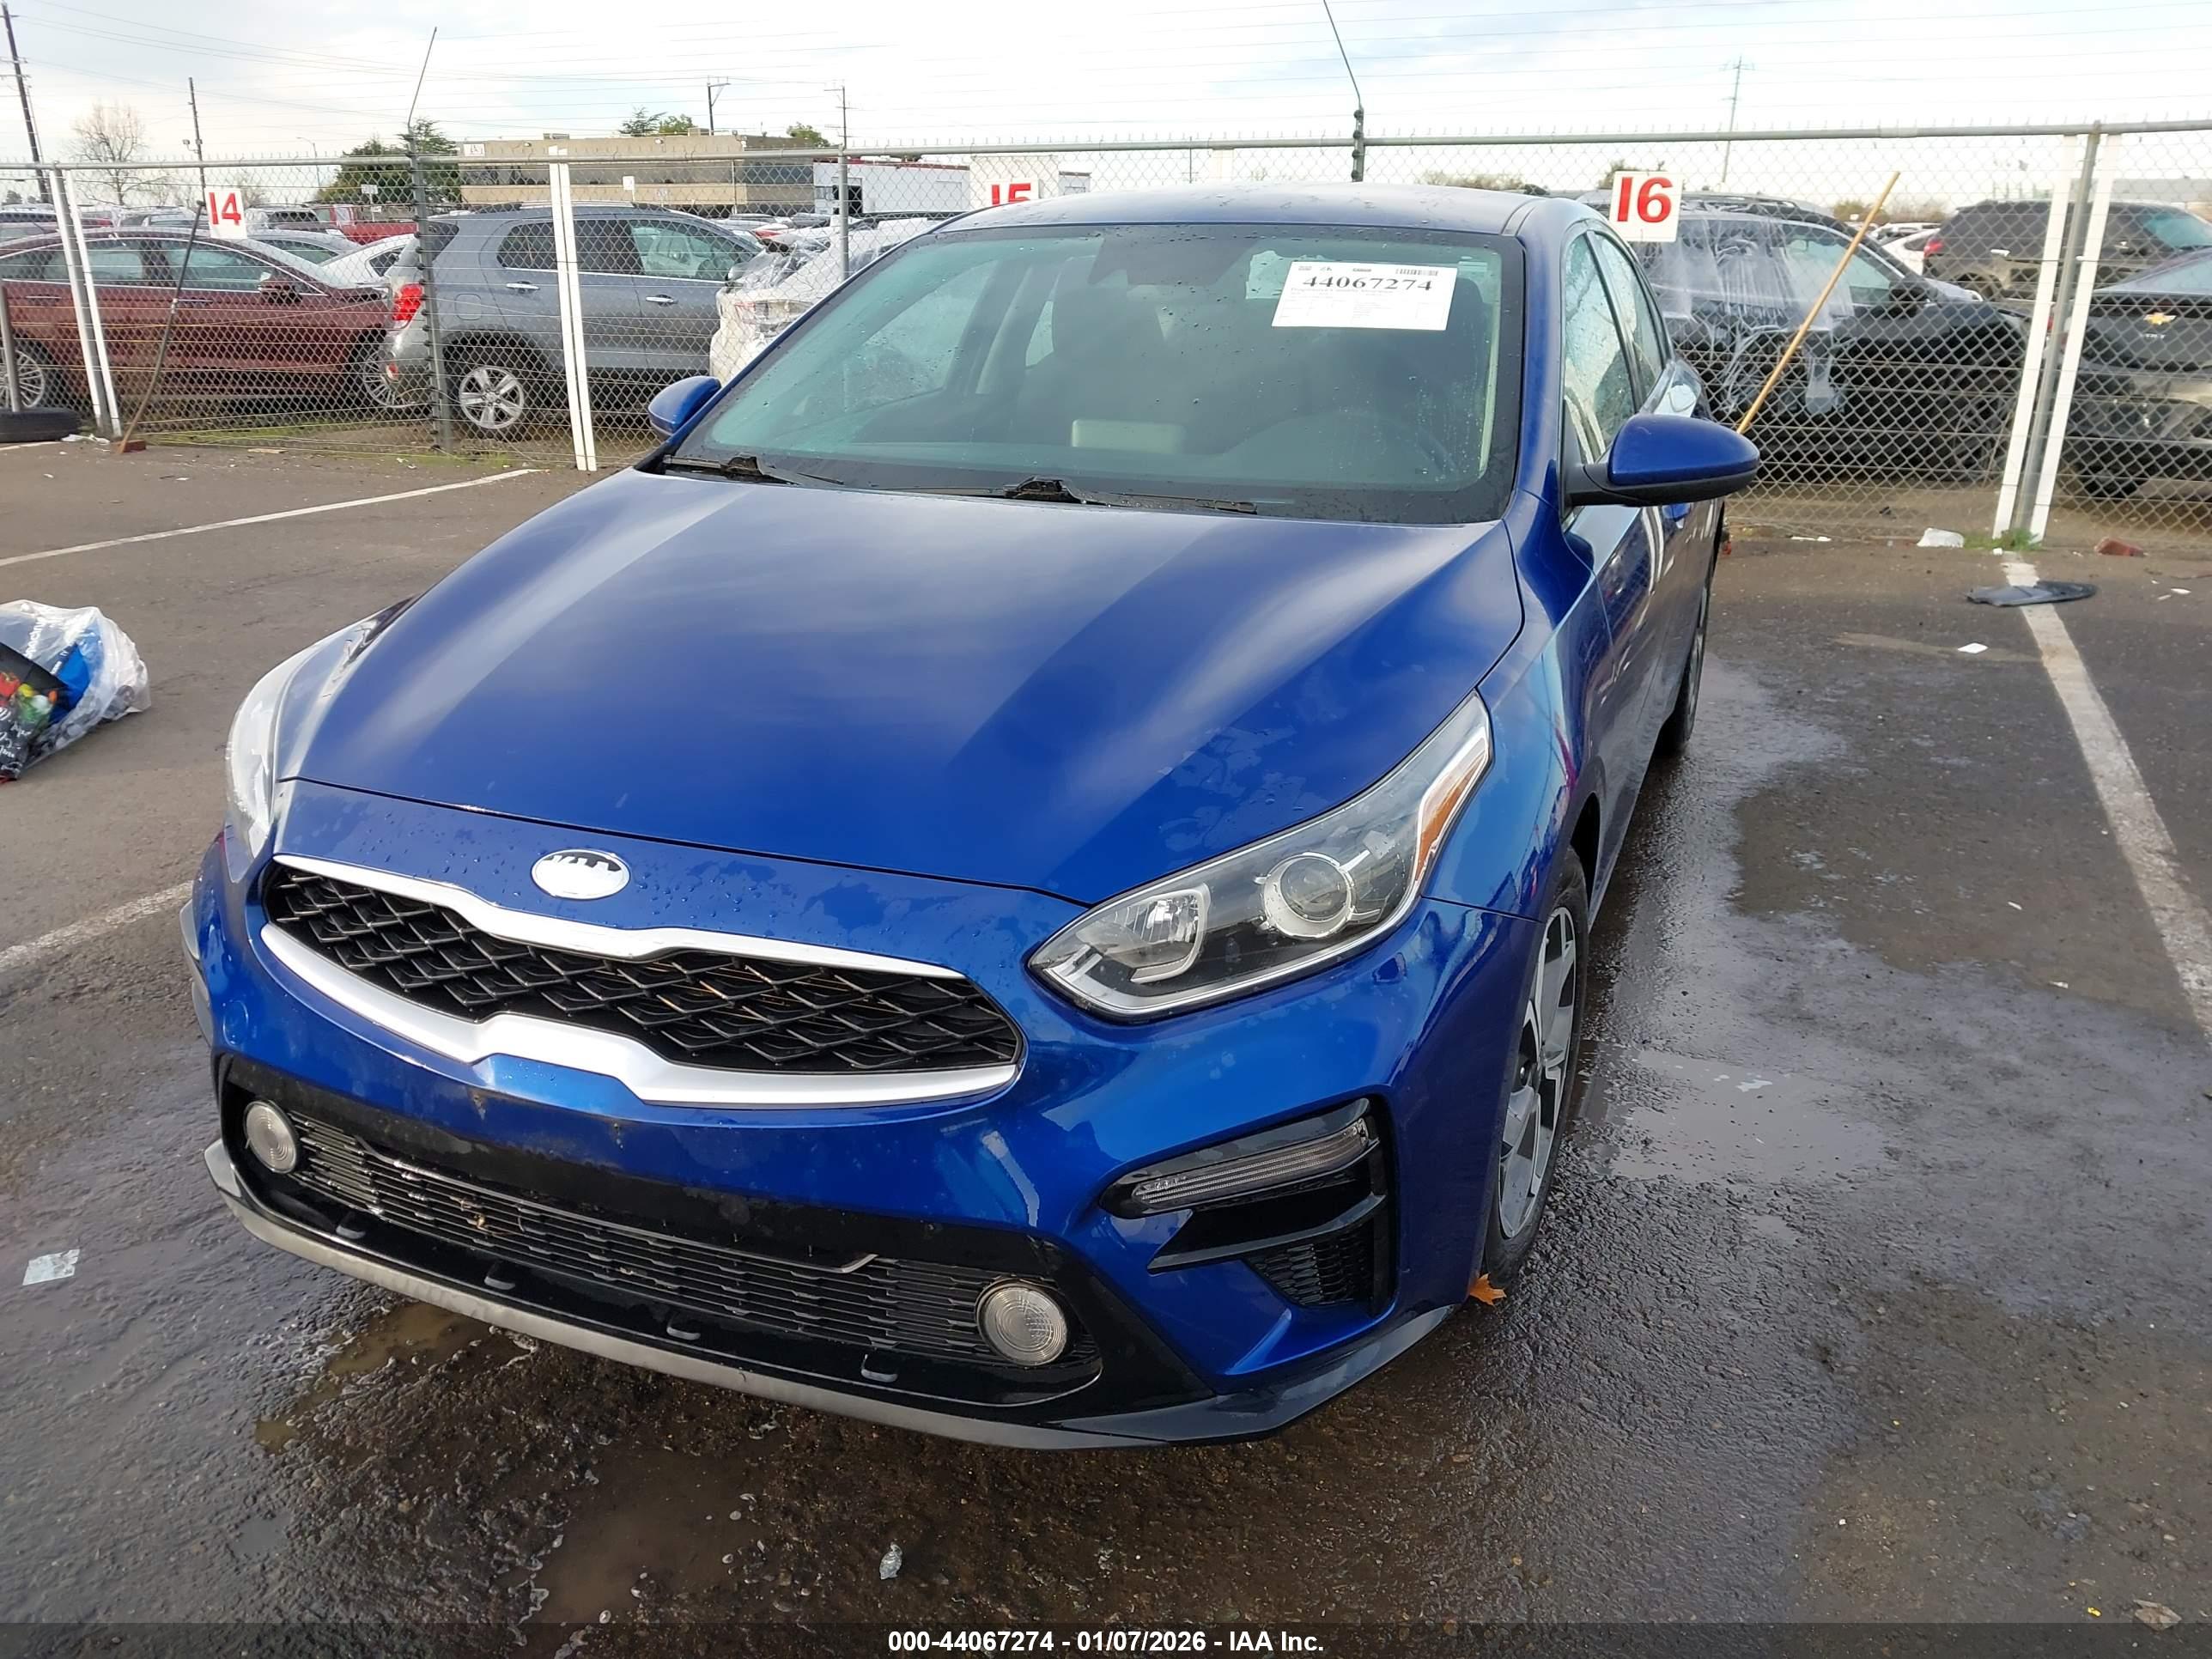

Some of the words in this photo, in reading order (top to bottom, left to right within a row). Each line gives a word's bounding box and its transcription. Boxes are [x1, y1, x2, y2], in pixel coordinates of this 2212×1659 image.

[209, 192, 241, 225] 14
[1617, 177, 1673, 223] 16
[1303, 276, 1432, 291] 44067274
